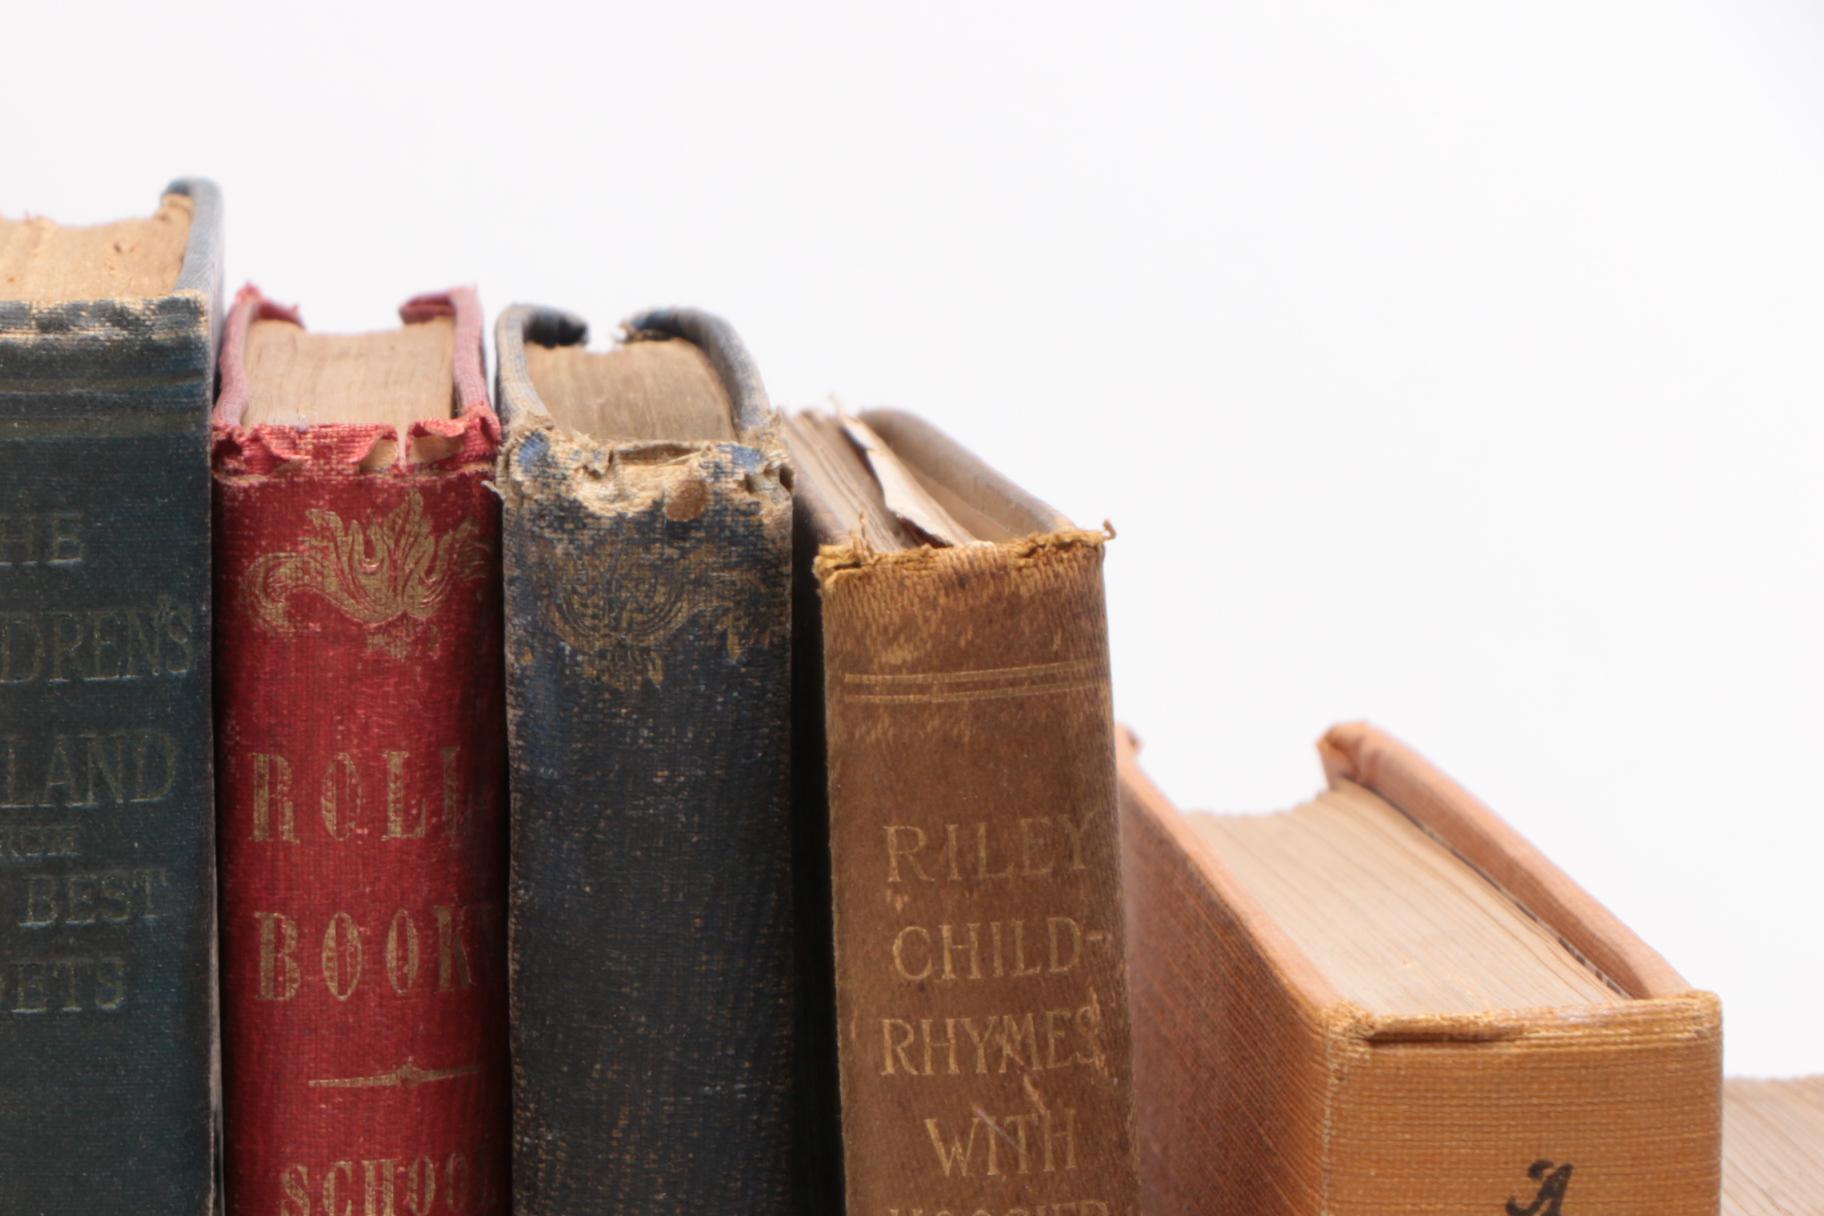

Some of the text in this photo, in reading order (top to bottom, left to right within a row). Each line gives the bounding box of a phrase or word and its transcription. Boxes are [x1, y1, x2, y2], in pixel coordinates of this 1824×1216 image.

[883, 812, 1098, 883] RILEY
[16, 868, 166, 928] BEST
[892, 917, 1113, 981] CHILD-
[881, 1005, 1101, 1075] RHYMES
[926, 1109, 1078, 1176] WITH
